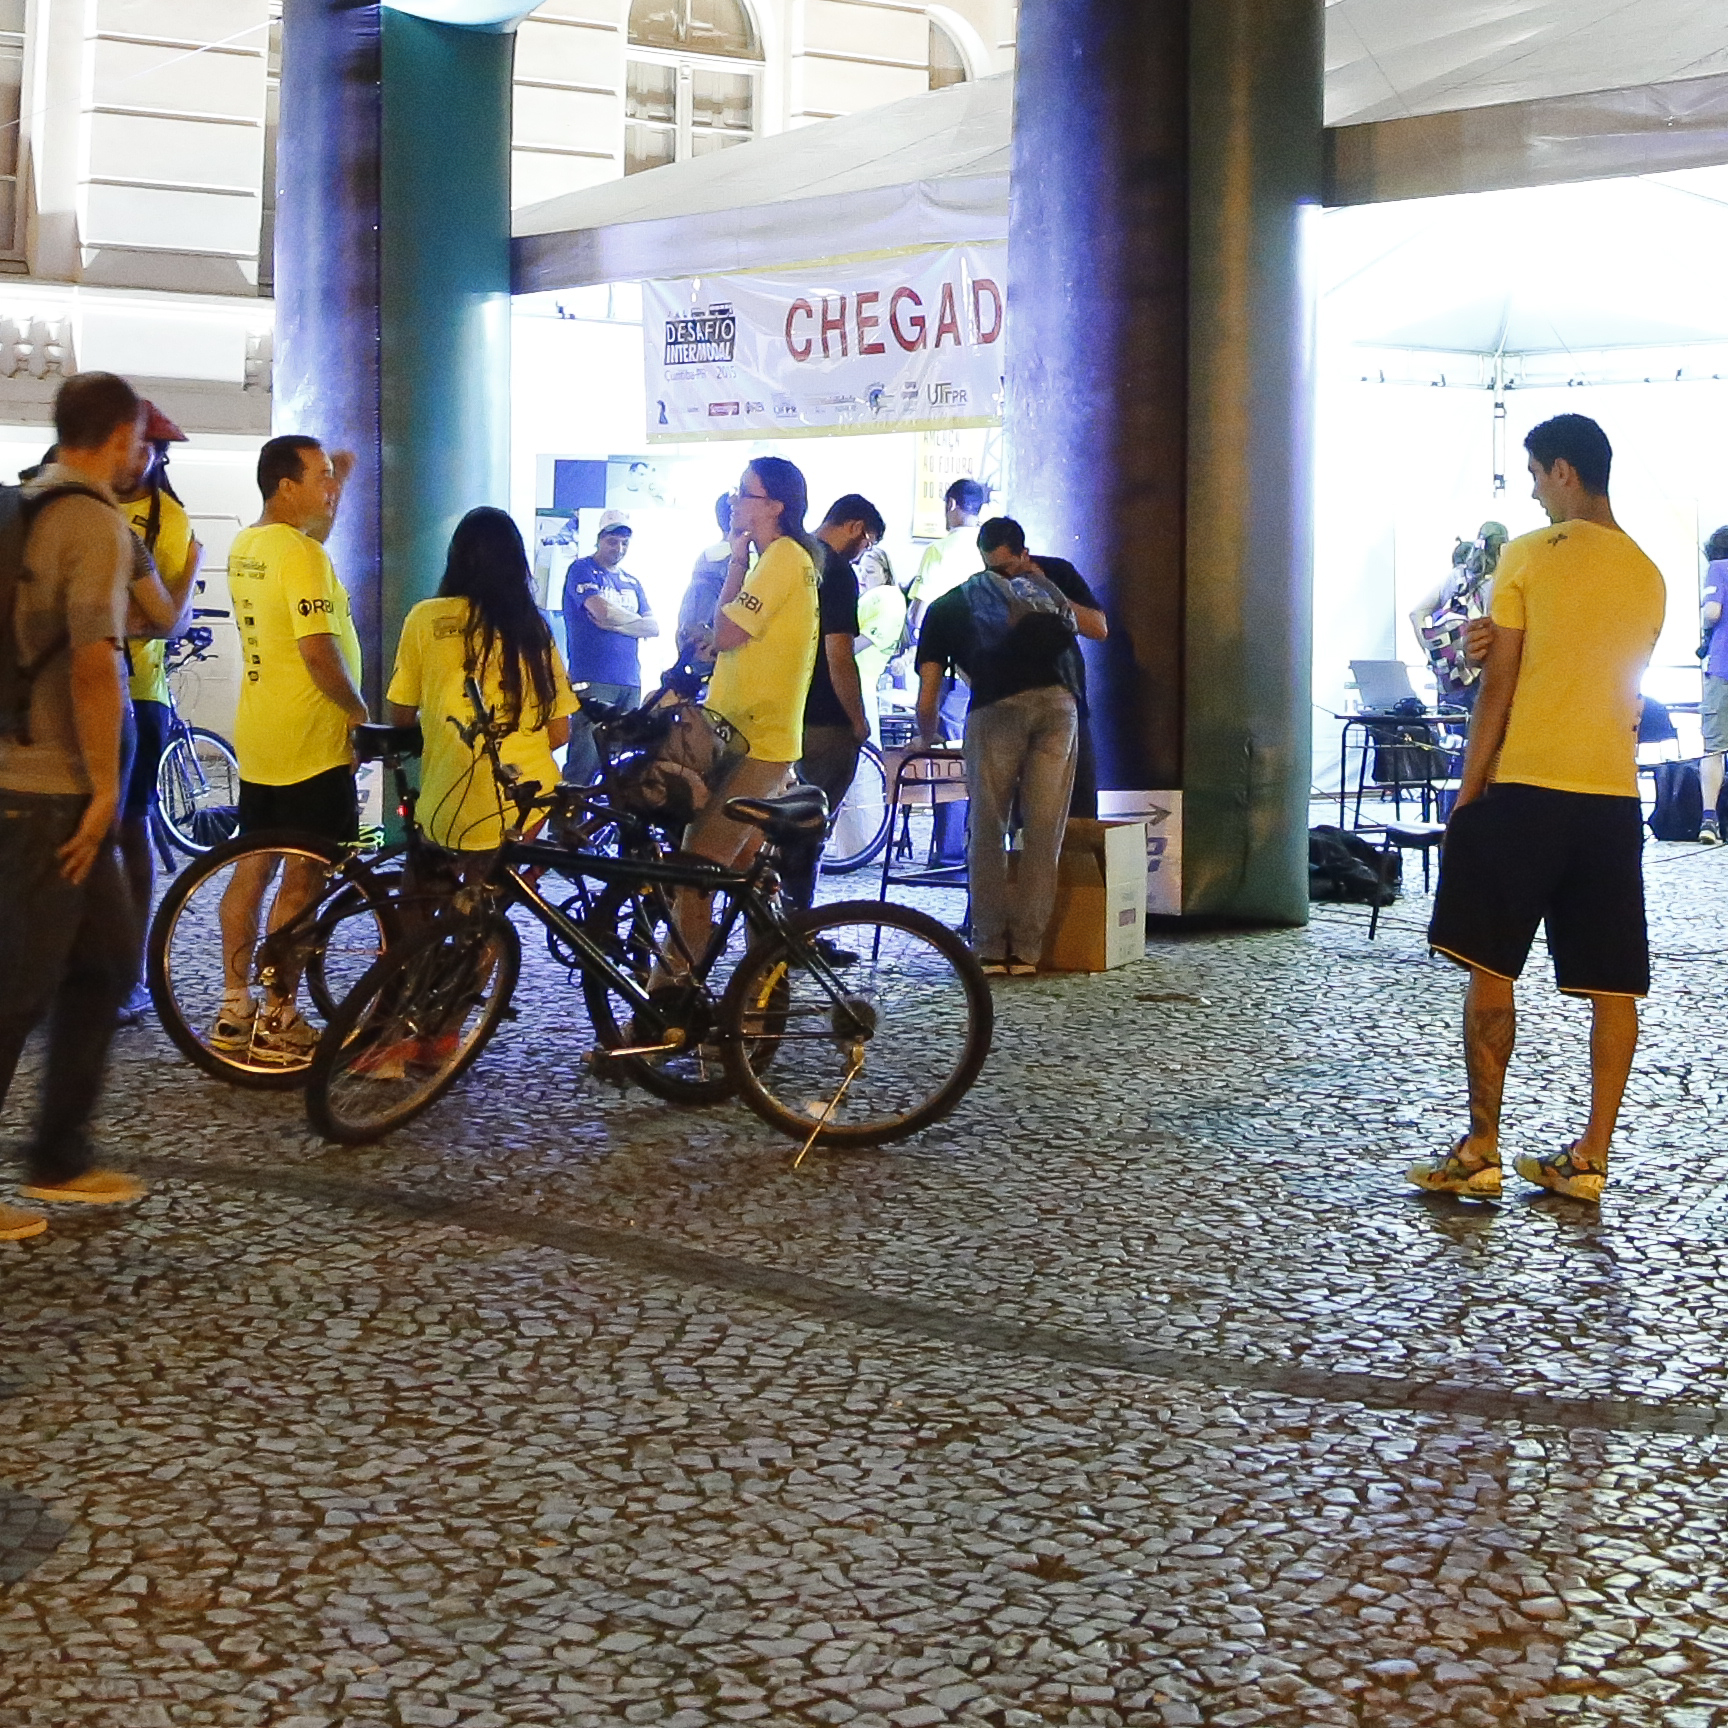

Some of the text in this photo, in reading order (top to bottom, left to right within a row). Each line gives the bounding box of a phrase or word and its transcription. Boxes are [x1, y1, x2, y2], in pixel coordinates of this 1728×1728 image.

[666, 319, 734, 343] DESAFIO
[785, 278, 1003, 363] CHEGAD
[665, 341, 732, 363] INTERMODAL
[737, 591, 764, 615] RBI
